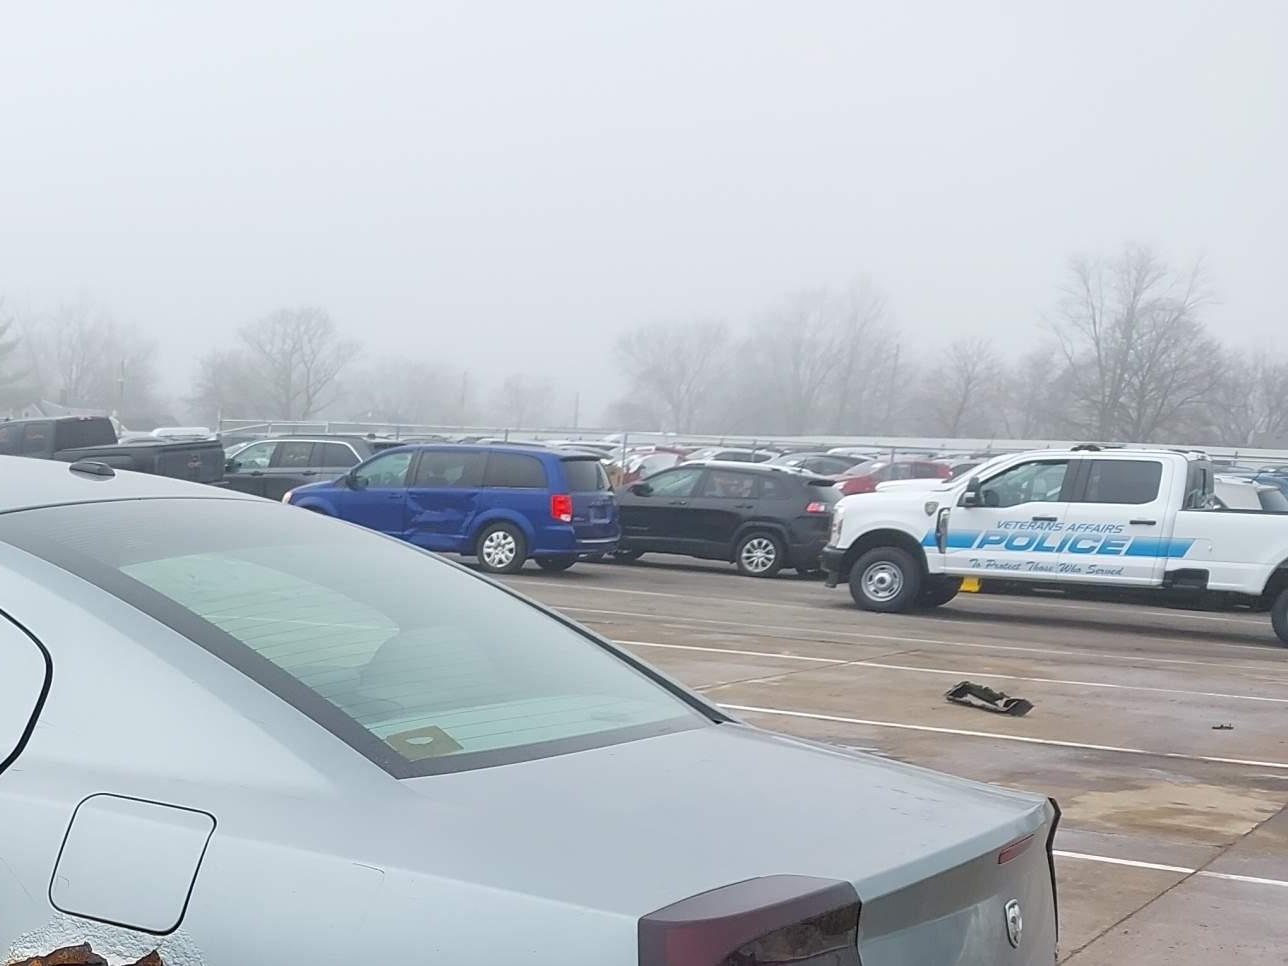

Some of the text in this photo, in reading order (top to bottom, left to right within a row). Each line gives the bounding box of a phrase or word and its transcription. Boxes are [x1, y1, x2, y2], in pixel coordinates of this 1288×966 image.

[996, 520, 1125, 534] VETERANS AFFAIRS
[975, 530, 1131, 556] POLICE
[969, 558, 981, 568] To
[985, 559, 1021, 570] Protect
[1058, 562, 1082, 573] Who
[1085, 564, 1124, 576] Served
